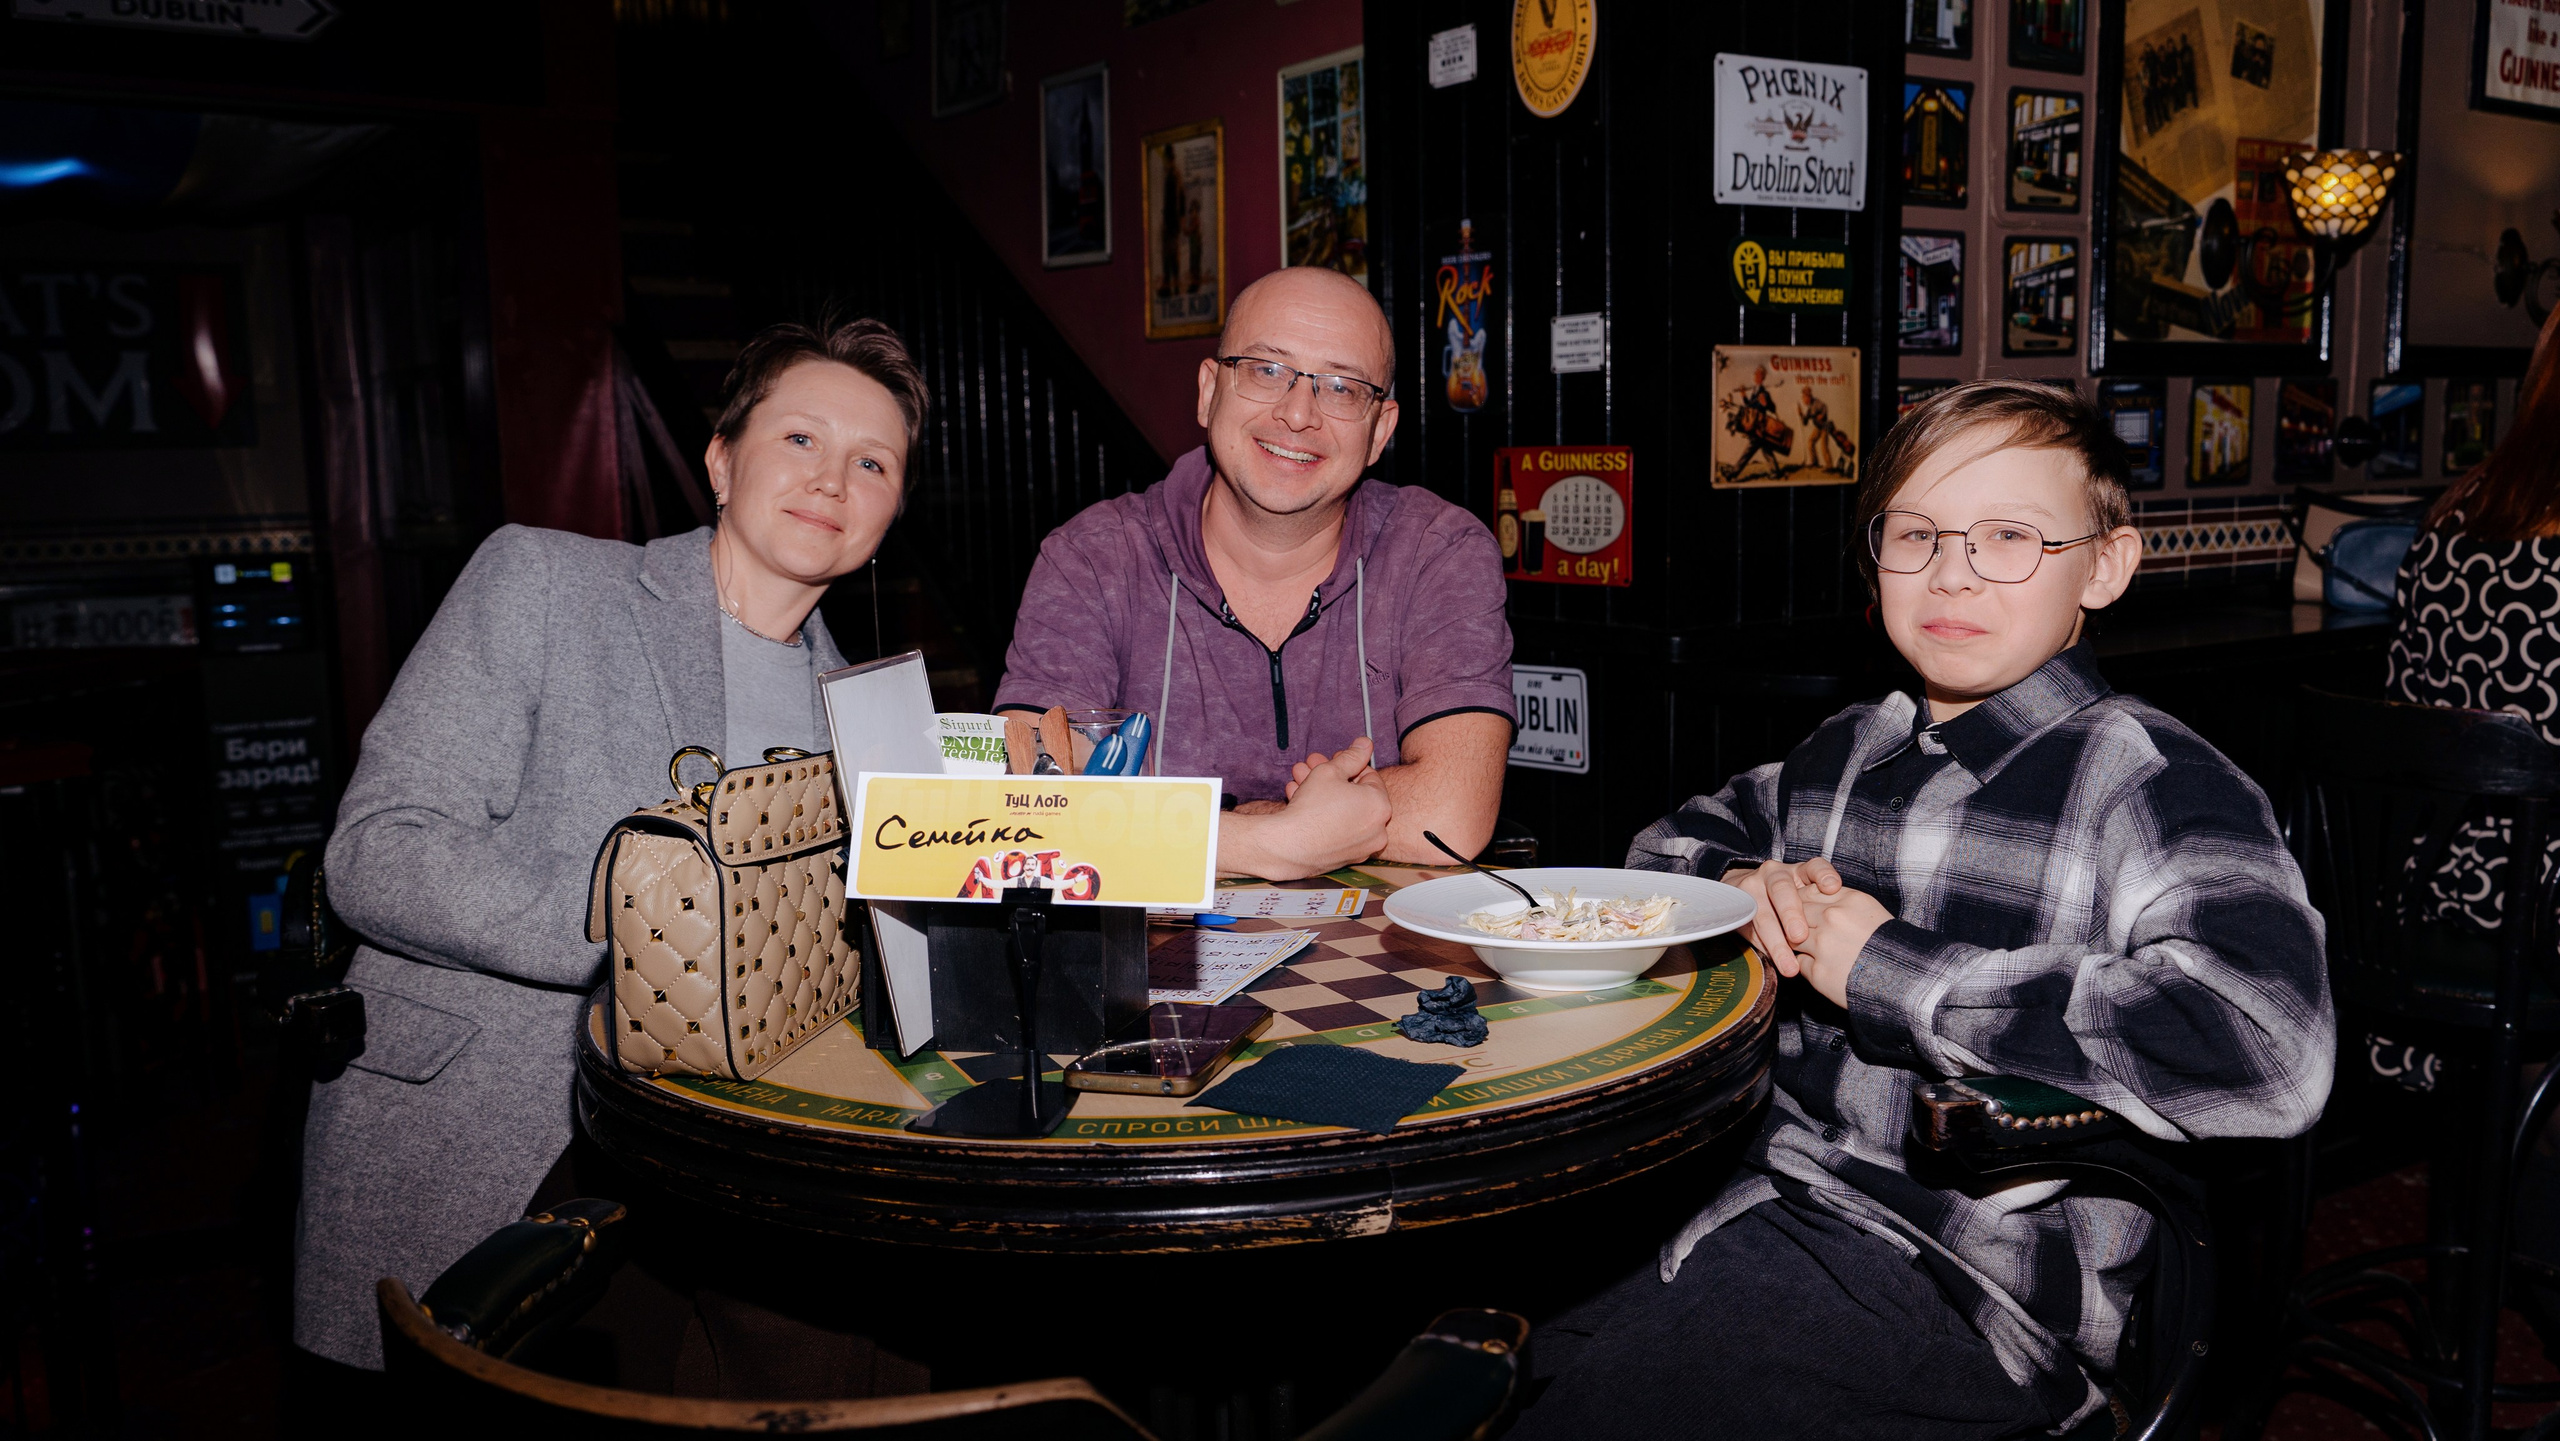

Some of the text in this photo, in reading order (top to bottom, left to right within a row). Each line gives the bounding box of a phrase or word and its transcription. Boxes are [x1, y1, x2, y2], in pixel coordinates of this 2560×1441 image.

[2501, 48, 2560, 92] GUINNE
[1731, 152, 1855, 196] Dublin Stout
[1768, 249, 1845, 269] ВЫ ПРИБЫЛИ
[1768, 268, 1815, 286] В ПУНКТ
[1435, 264, 1495, 336] Rock
[1768, 287, 1845, 305] НАЗНАЧЕНИЯ!
[1770, 354, 1832, 372] GUINNESS
[1521, 450, 1627, 471] A GUINNESS
[1557, 556, 1619, 583] a day!
[940, 718, 993, 733] Sigurd
[1513, 693, 1577, 735] UBLIN
[224, 736, 307, 762] Бери
[939, 735, 1006, 752] ENCHA
[941, 746, 979, 761] reen
[216, 757, 322, 791] заряд!
[875, 814, 1045, 851] Семейка
[1077, 1120, 1220, 1134] СПРОСИ
[1453, 1069, 1574, 1103] ШАШКИ
[1591, 1026, 1689, 1068] БАРМЕНА
[1685, 969, 1736, 1018] HARATS.COM
